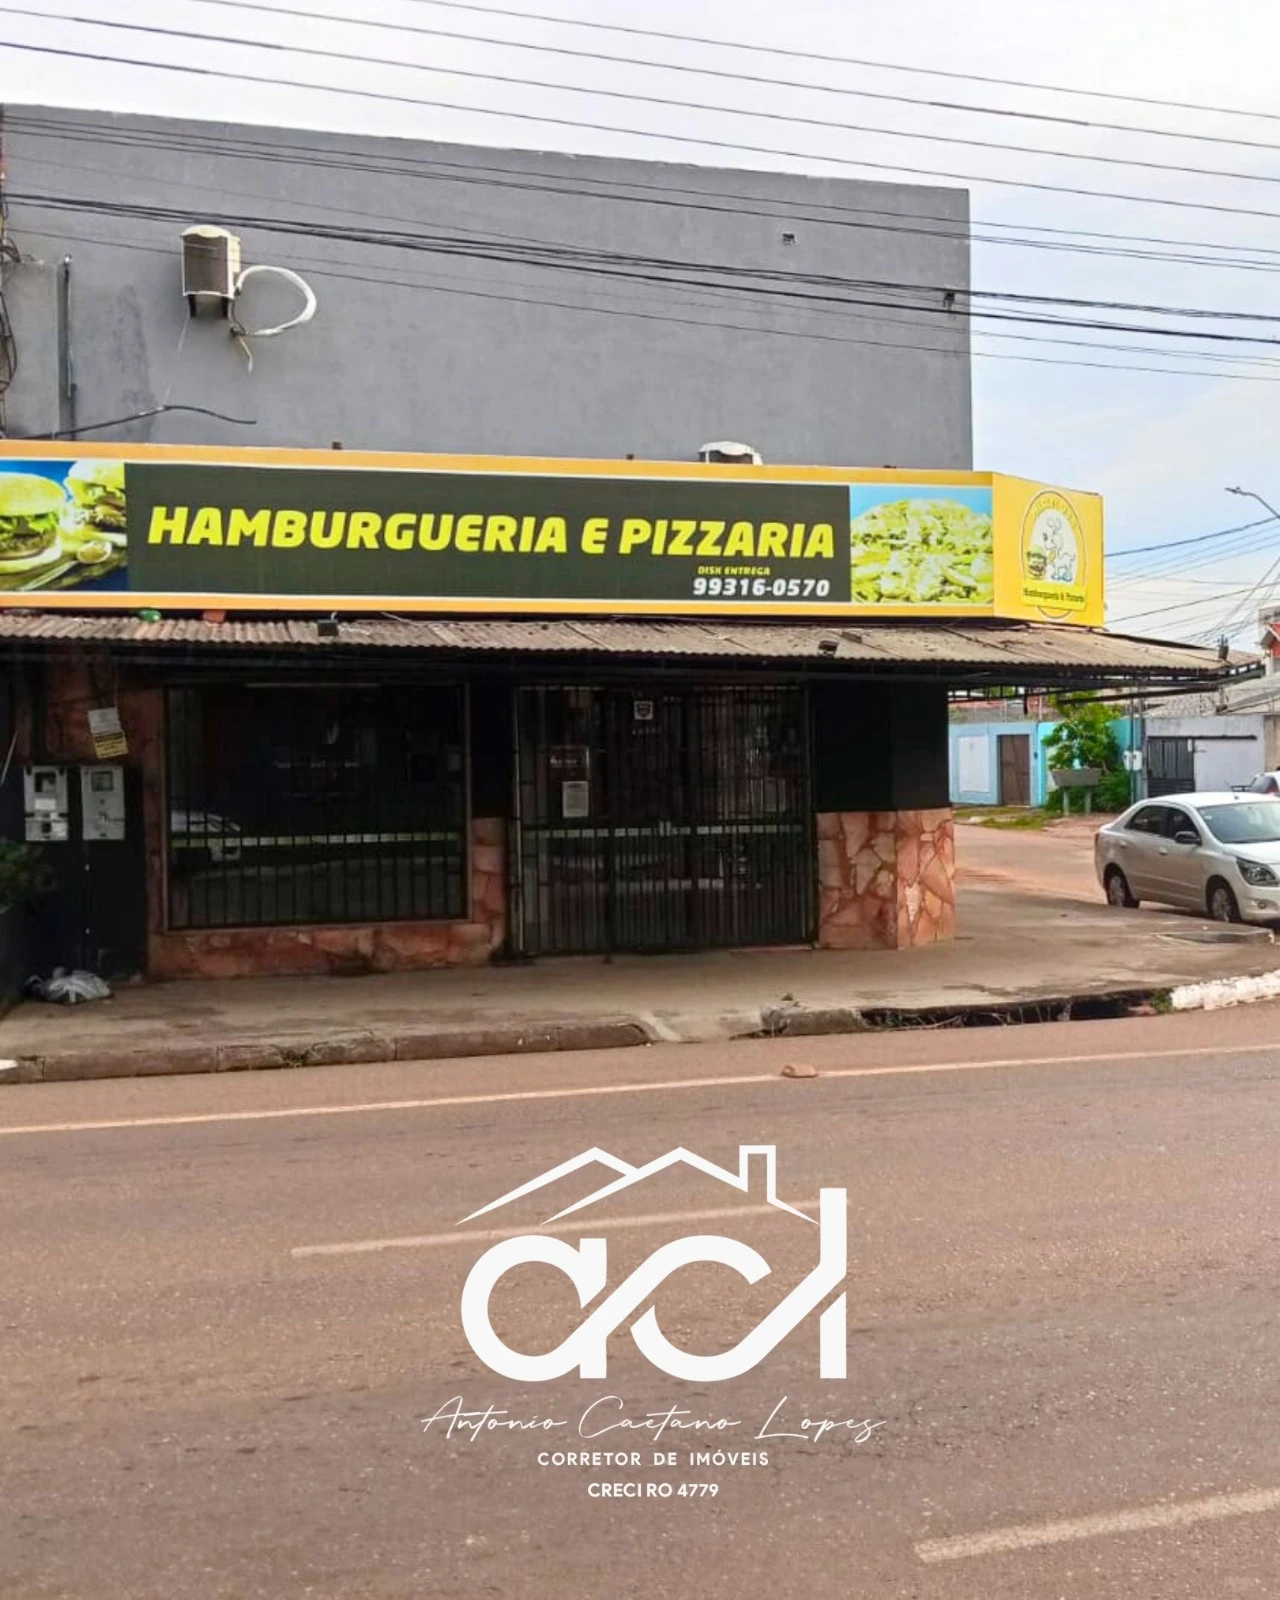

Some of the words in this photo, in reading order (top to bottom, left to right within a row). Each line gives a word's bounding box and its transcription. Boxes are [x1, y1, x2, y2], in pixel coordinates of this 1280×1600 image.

[148, 506, 567, 554] HAMBURGUERIA
[581, 518, 609, 554] E
[619, 519, 835, 560] PIZZARIA
[698, 566, 721, 575] DISK
[724, 566, 771, 576] ENTREGA
[693, 577, 830, 597] 99316-0570
